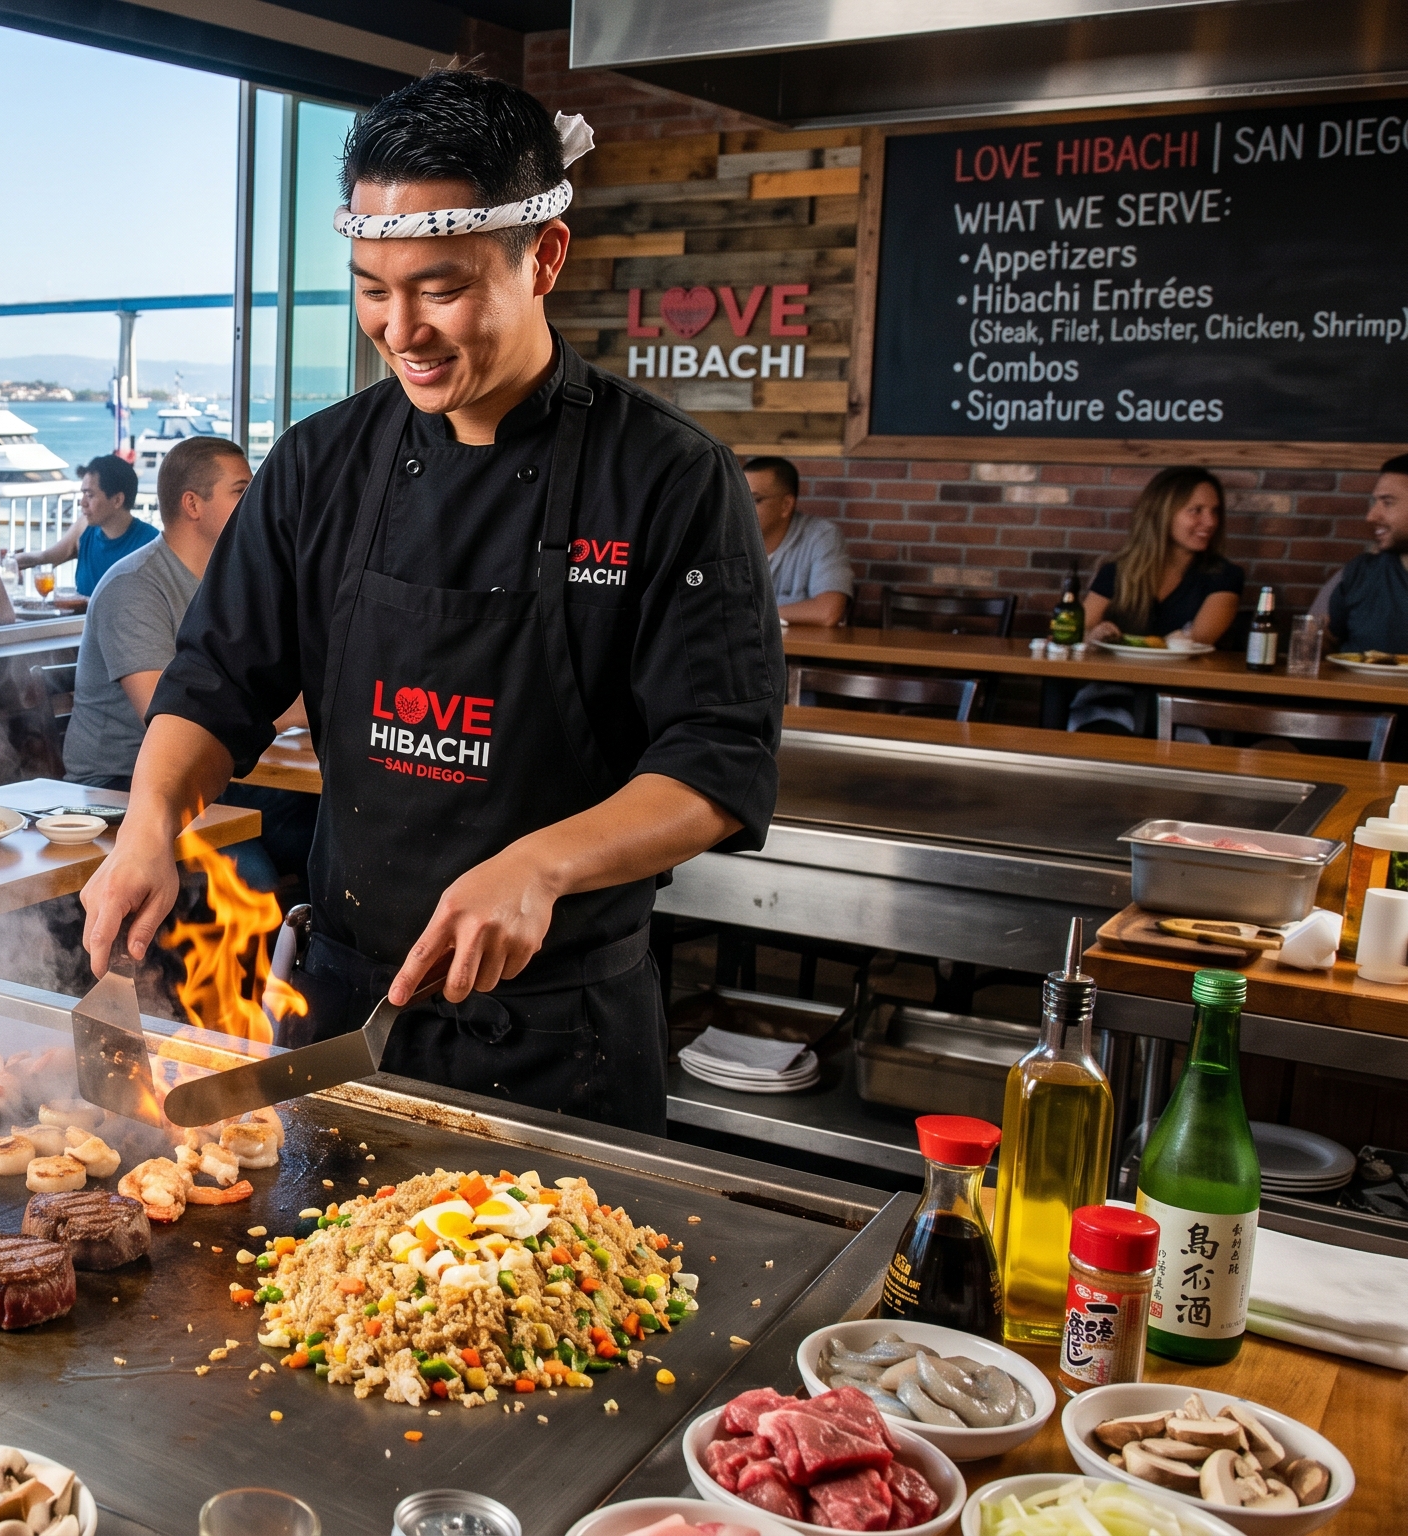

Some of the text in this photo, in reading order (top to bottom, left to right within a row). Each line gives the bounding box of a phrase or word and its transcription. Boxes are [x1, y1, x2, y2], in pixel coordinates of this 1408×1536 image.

[955, 141, 1042, 182] LOVE
[1056, 132, 1198, 175] HIBACHI
[1234, 124, 1303, 164] SAN
[1319, 117, 1408, 158] DIEG
[954, 189, 1231, 235] WHAT WE SERVE:
[973, 241, 1137, 280] Appetizers
[972, 276, 1213, 315] Hibachi Entrées
[1205, 313, 1305, 342] Chicken,
[627, 344, 806, 378] HIBACHI
[967, 351, 1079, 383] Combos
[966, 388, 1224, 431] Signature Sauces
[570, 538, 630, 565] OVE
[568, 566, 627, 586] BACHI
[370, 722, 490, 767] HIBACHI
[384, 757, 465, 784] SAN DIEGO
